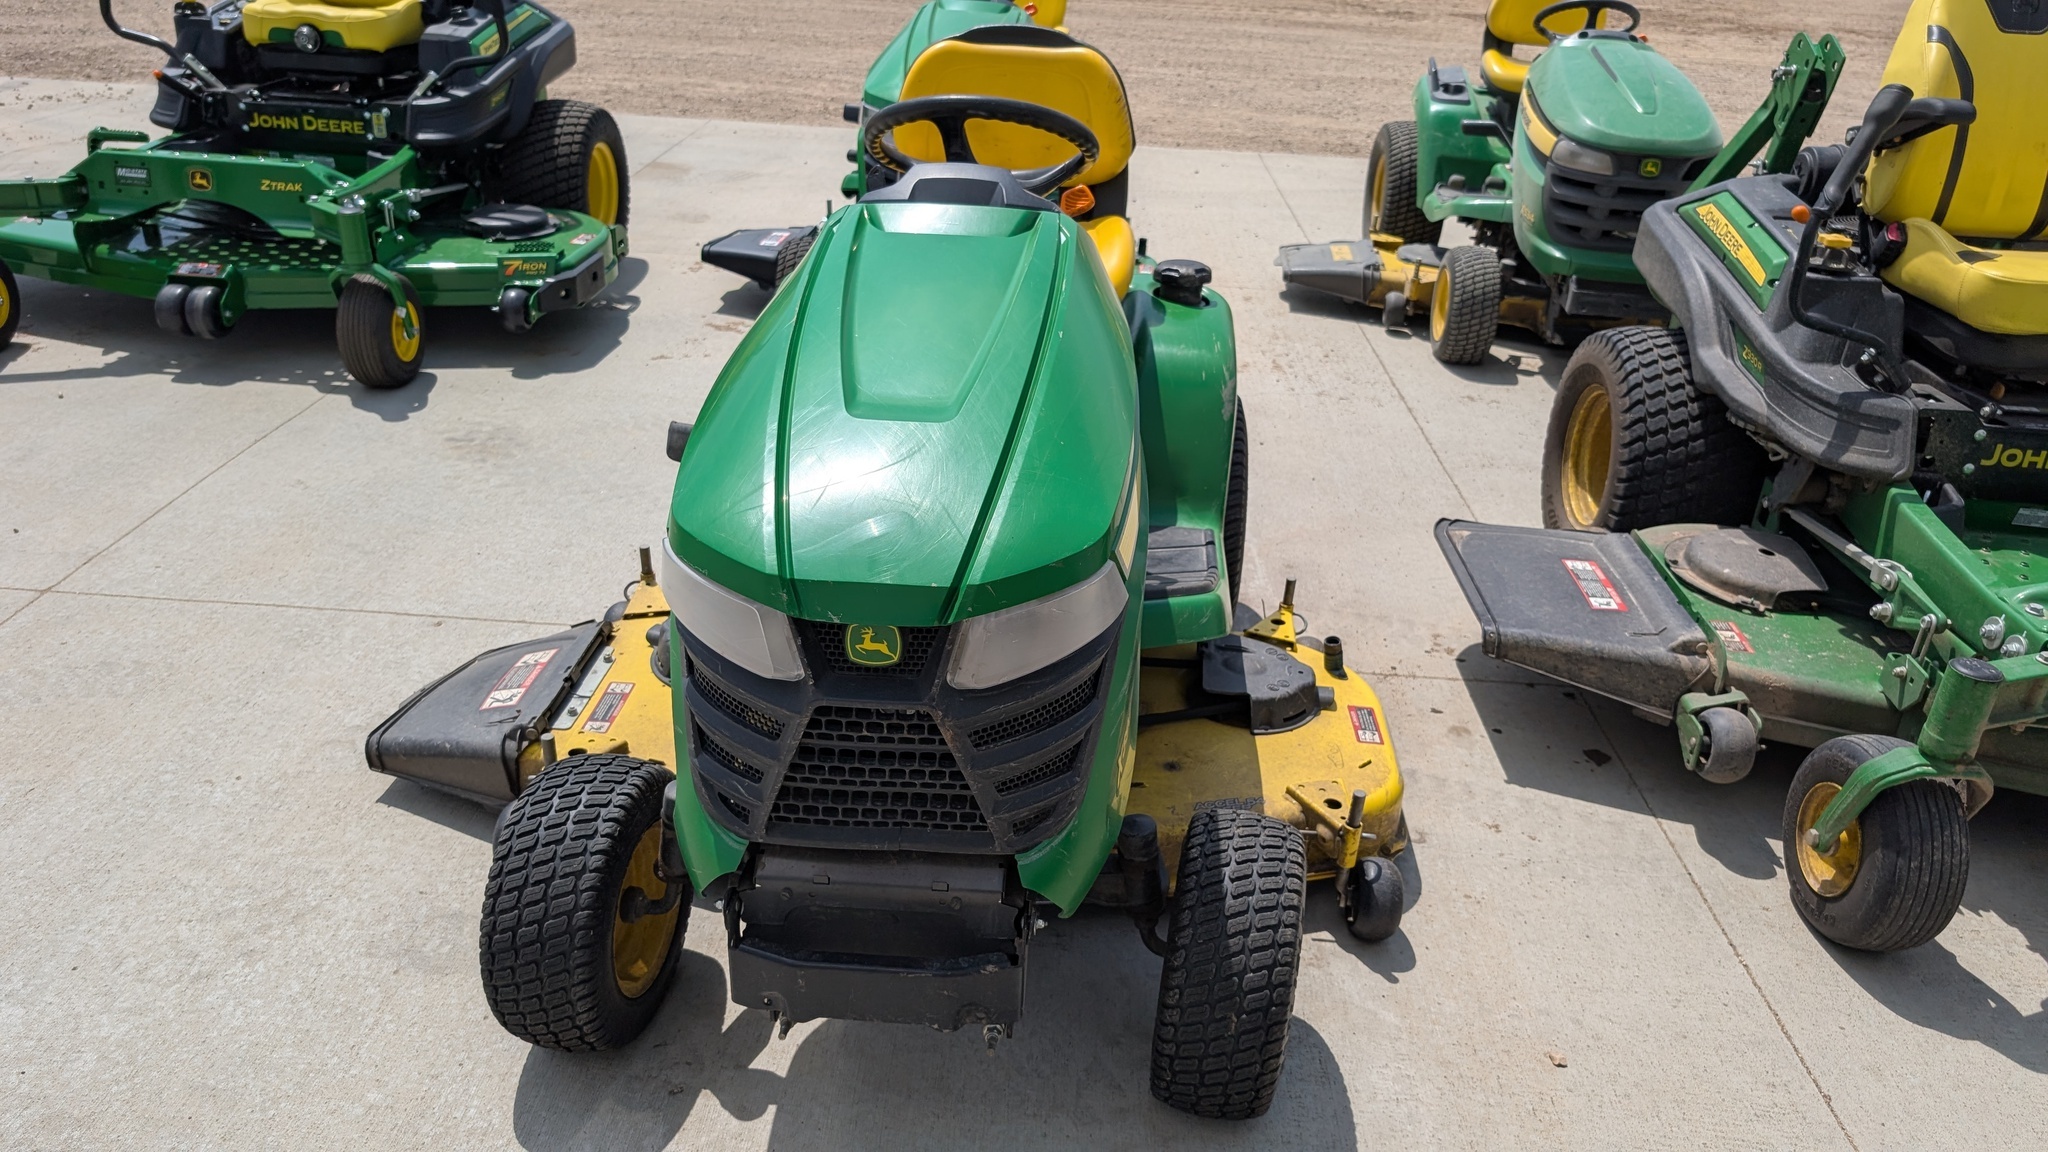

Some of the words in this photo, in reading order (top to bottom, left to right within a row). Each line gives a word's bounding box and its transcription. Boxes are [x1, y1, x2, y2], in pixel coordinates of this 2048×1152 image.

[249, 112, 299, 130] JOHN
[302, 115, 366, 134] DEERE
[260, 179, 303, 192] ZTRAK
[1701, 206, 1722, 233] JOHN
[1718, 223, 1744, 257] DEERE
[1980, 443, 2048, 470] JOH
